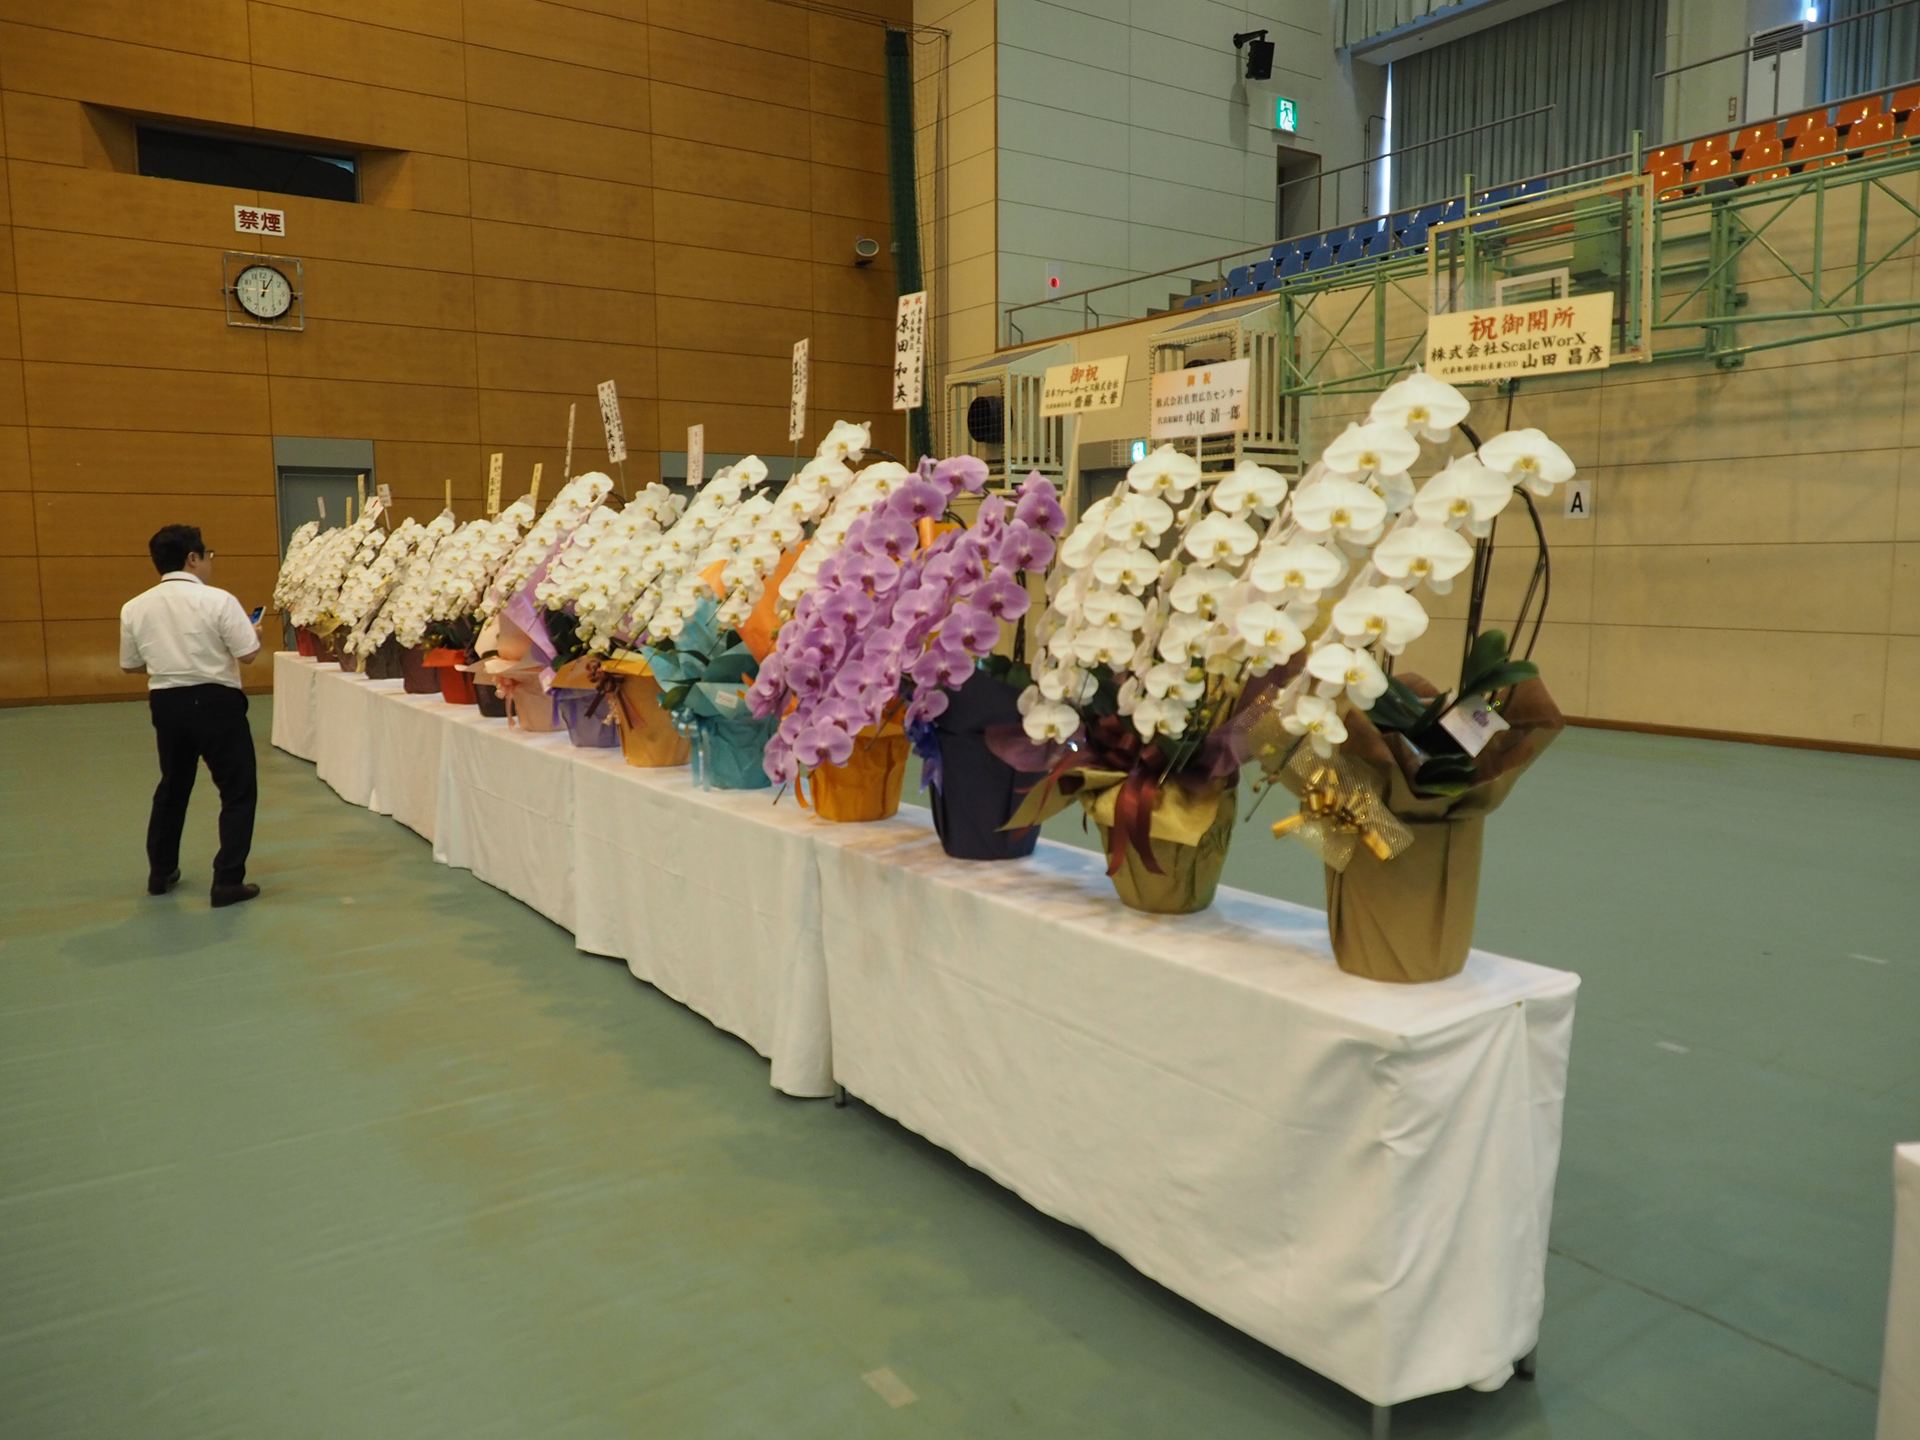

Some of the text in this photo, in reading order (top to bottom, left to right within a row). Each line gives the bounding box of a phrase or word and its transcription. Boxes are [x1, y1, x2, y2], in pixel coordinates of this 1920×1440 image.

[238, 209, 281, 232] 禁煙
[1469, 306, 1576, 342] 祝御開所
[1522, 352, 1556, 369] 山田
[1070, 364, 1099, 384] 御祝
[1186, 409, 1206, 425] 中尾
[1571, 491, 1583, 512] A
